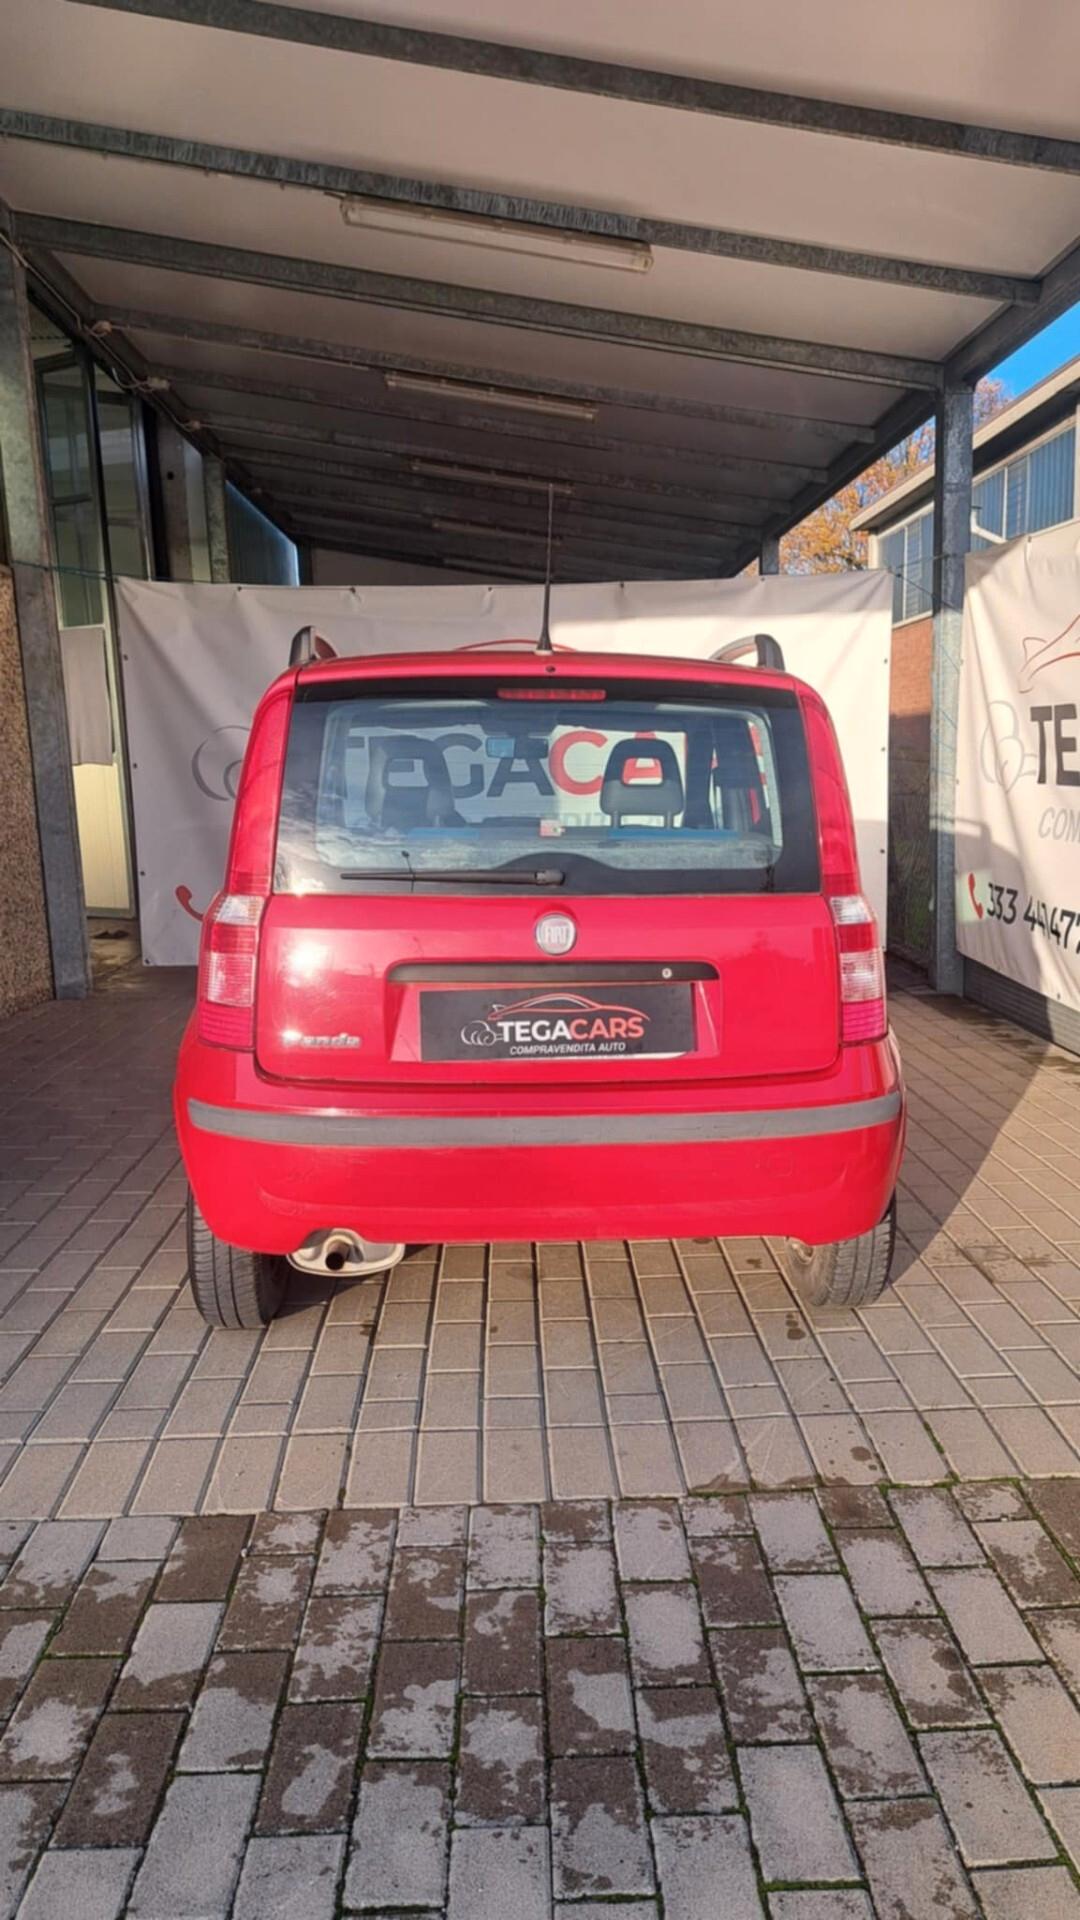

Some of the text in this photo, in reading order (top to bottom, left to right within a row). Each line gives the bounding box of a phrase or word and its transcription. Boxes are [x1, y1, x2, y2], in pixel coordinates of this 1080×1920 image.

[987, 881, 1018, 924] 333
[497, 1017, 644, 1042] TEGACARS
[510, 1041, 626, 1055] COMPRAVENDITA AUTO
